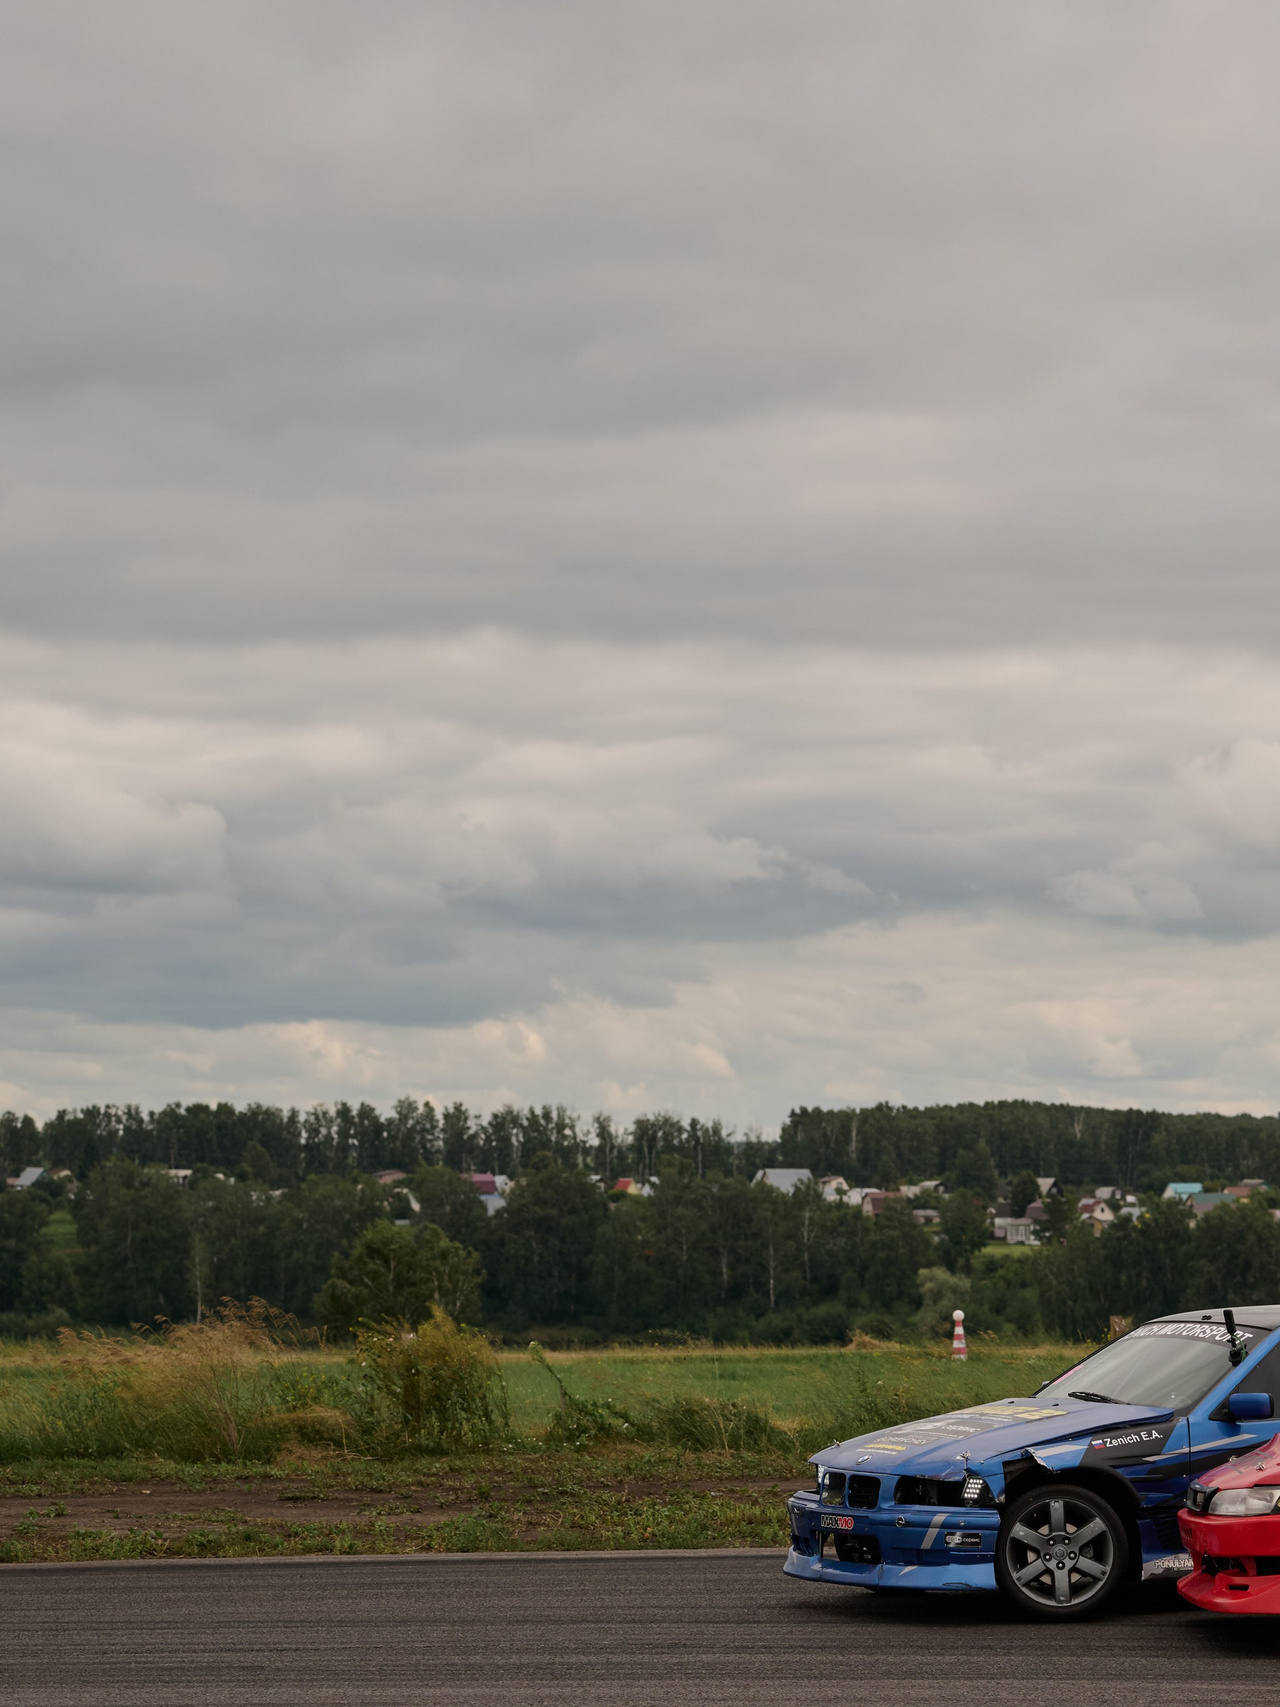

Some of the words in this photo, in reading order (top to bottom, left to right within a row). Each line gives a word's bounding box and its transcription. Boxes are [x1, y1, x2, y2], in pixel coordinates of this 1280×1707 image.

[1156, 1323, 1254, 1345] MOTORSPORT
[1104, 1433, 1140, 1447] Zenich
[1140, 1430, 1163, 1441] E.A.
